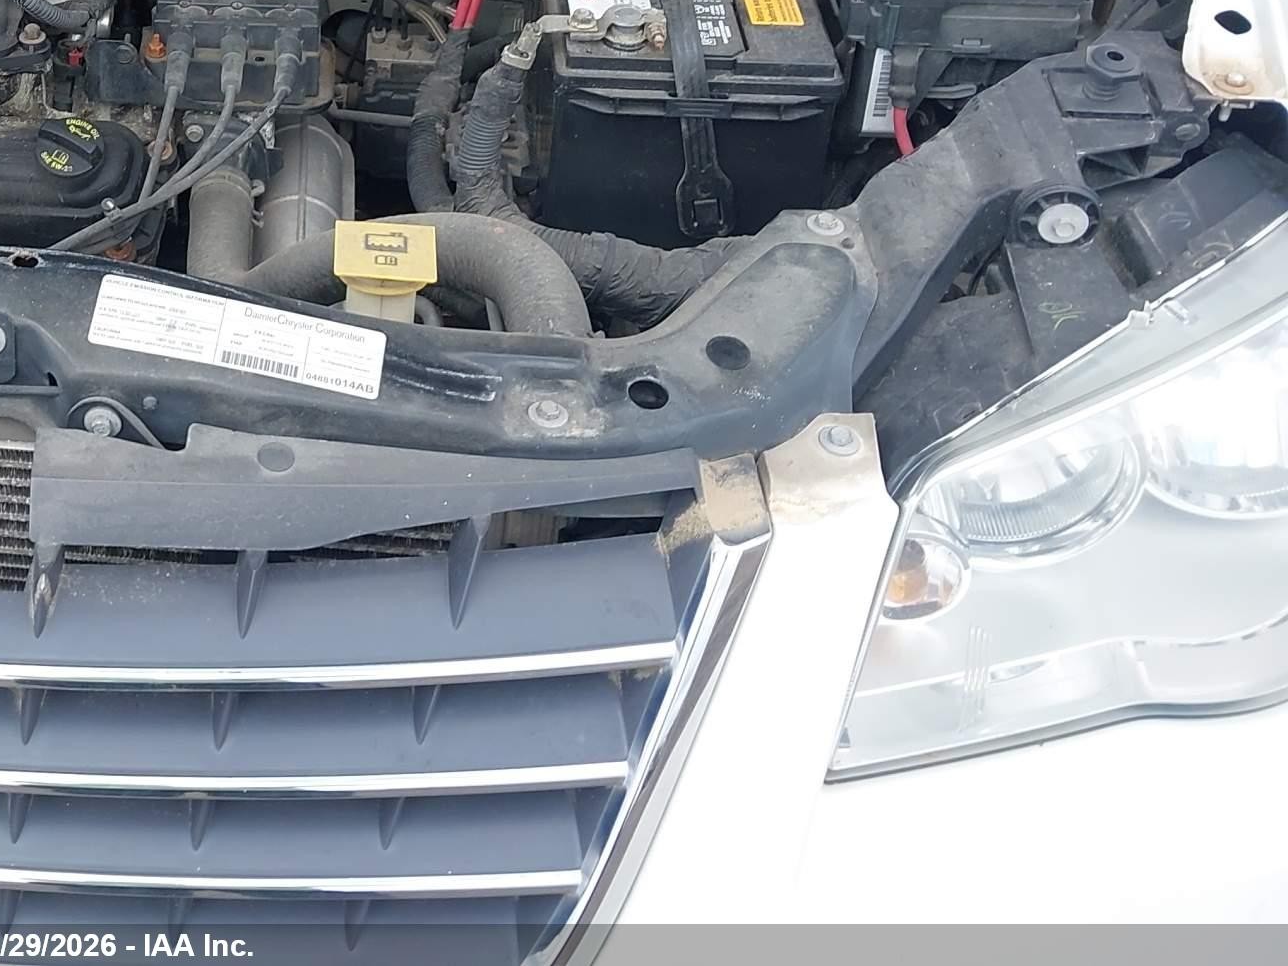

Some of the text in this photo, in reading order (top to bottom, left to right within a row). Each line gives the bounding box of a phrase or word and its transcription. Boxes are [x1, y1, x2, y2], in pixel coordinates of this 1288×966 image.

[65, 118, 101, 140] ENGINE OIL
[243, 306, 314, 331] DaimlerChrysler
[314, 322, 365, 344] Corporation
